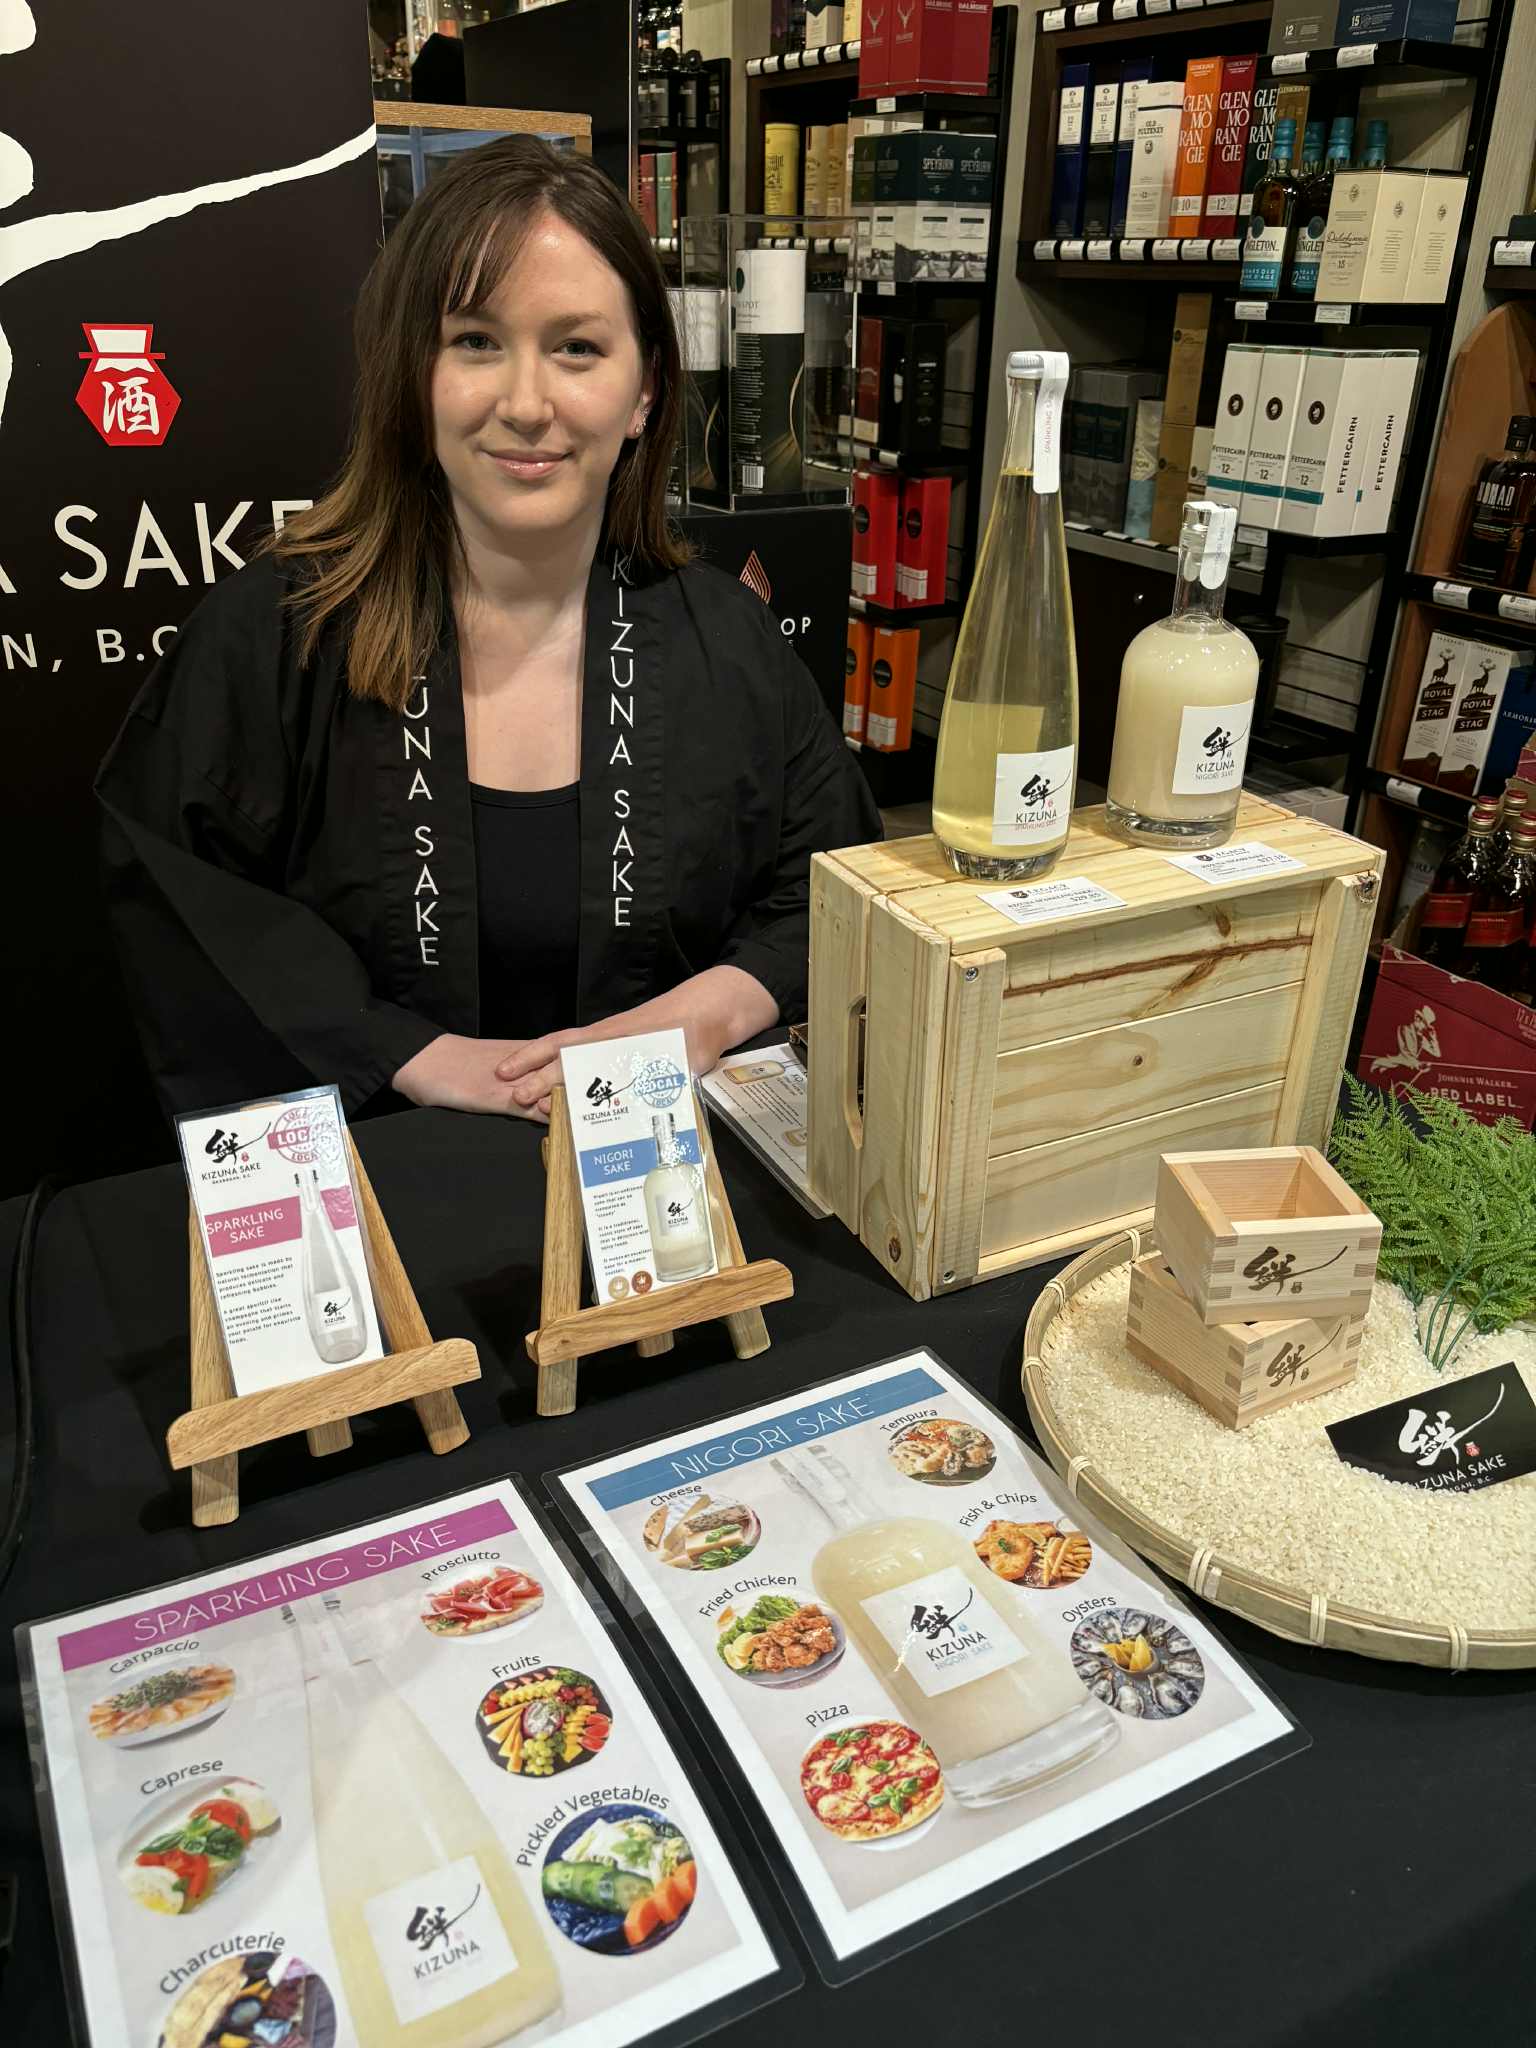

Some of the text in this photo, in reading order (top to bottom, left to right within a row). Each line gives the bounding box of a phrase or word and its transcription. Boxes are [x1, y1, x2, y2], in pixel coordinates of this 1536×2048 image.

[1183, 93, 1213, 112] GLEN
[1220, 90, 1251, 110] GLEN
[1191, 111, 1212, 128] MO
[1226, 109, 1249, 127] MO
[1179, 130, 1203, 147] RAN
[1215, 126, 1240, 145] RAN
[1249, 125, 1275, 143] RAN
[1186, 146, 1205, 164] GIE
[1222, 144, 1242, 162] GIE
[1256, 143, 1272, 160] GI
[1182, 199, 1191, 211] 10
[1216, 198, 1226, 211] 12
[102, 377, 160, 436] 酒
[1336, 416, 1359, 494] FETTERCAIRN
[1374, 414, 1396, 492] FETTERCAIRN
[1221, 463, 1231, 474] 12
[1259, 469, 1269, 480] 12
[1300, 474, 1310, 486] 12
[1423, 688, 1452, 699] ROYAL
[1421, 708, 1445, 718] STAG
[1461, 699, 1492, 710] ROYAL
[1459, 720, 1484, 729] STAG
[609, 549, 635, 927] KIZUNA SAKE
[1196, 760, 1235, 773] KIZUNA
[1016, 809, 1057, 824] KIZUNA
[414, 825, 441, 966] SAKE
[1428, 1085, 1517, 1109] RED LABEL
[582, 1105, 629, 1121] KIZUNA SAKE
[593, 1149, 634, 1166] NIGORI
[202, 1162, 262, 1181] KIZUNA SAKE
[603, 1162, 632, 1176] SAKE
[206, 1208, 285, 1235] SPARKLING
[230, 1226, 265, 1245] SAKE
[880, 1407, 939, 1434] Tempura
[670, 1396, 875, 1480] NIGORI SAKE
[1467, 1454, 1507, 1476] SAKE
[650, 1483, 703, 1509] Cheese
[958, 1491, 1038, 1528] Fish & Chips
[420, 1550, 502, 1583] Prosciutto
[133, 1520, 457, 1645] SPARKLING SAKE
[699, 1573, 797, 1619] Fried Chicken
[1061, 1593, 1117, 1625] Oysters
[925, 1630, 987, 1663] KIZUNA
[108, 1638, 201, 1676] Carpaccio
[490, 1652, 542, 1680] Fruits
[805, 1701, 850, 1728] Pizza
[139, 1757, 224, 1797] Caprese
[514, 1784, 672, 1868] Pickled Vegetables
[158, 1929, 286, 1997] Charcuterie
[414, 1940, 481, 1980] KIZUNA
